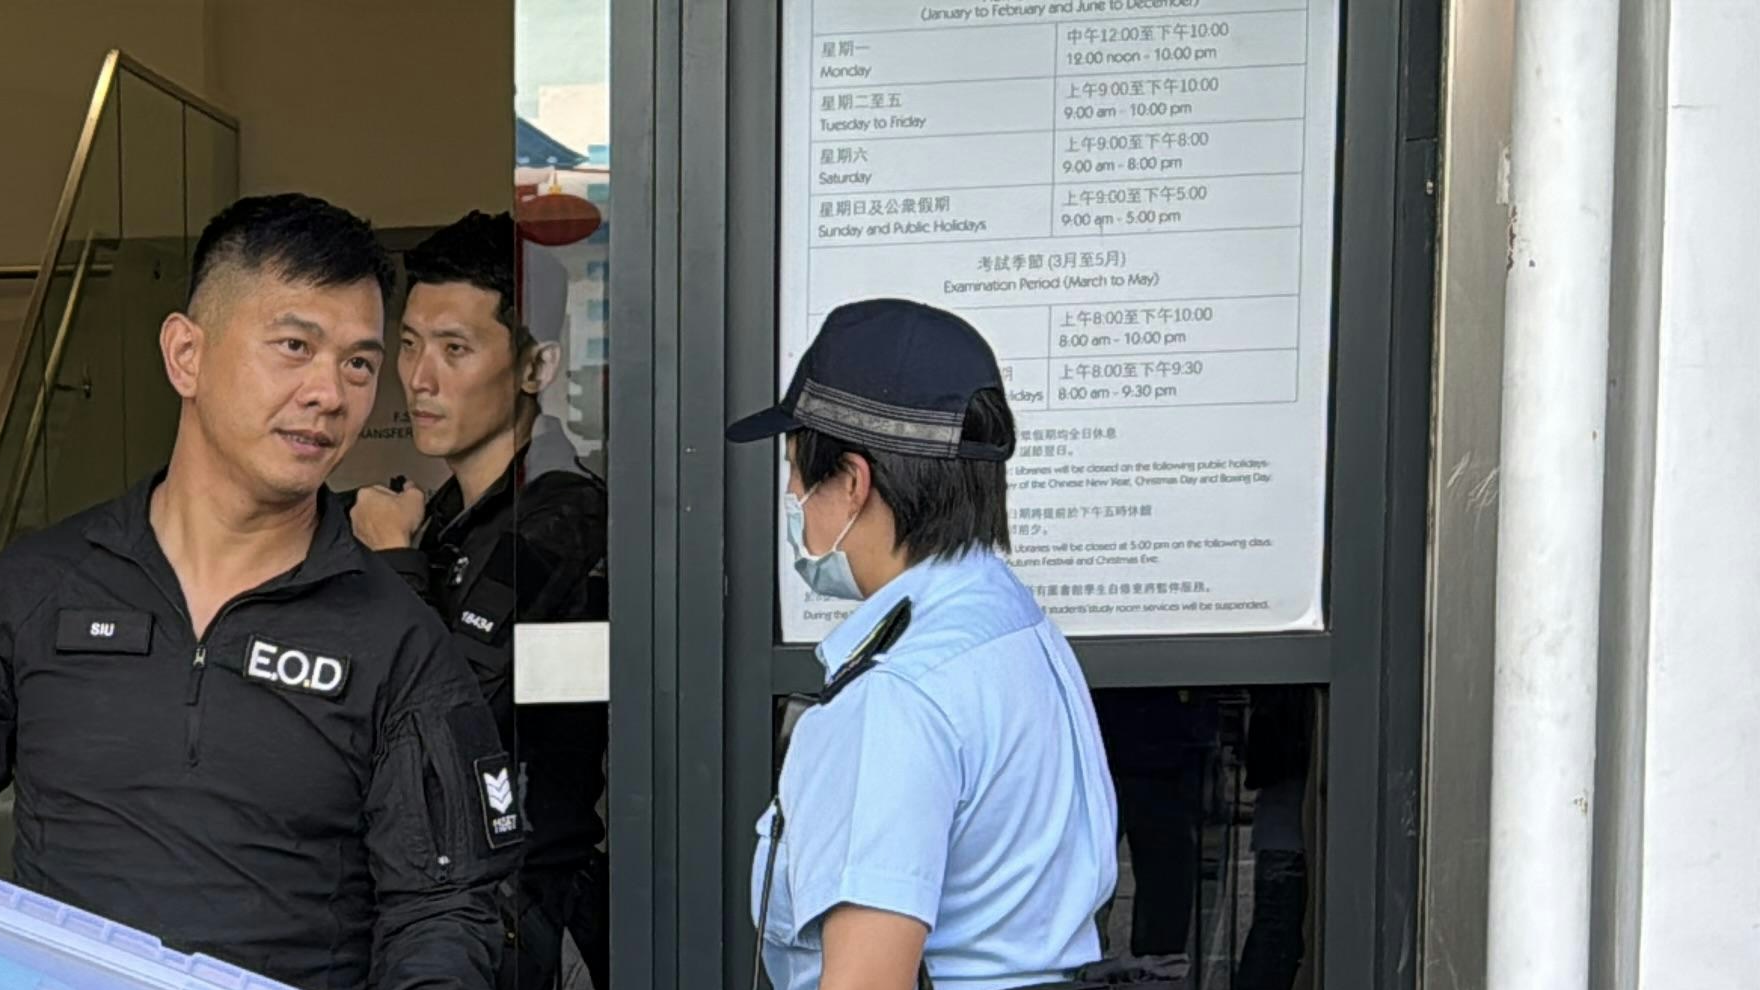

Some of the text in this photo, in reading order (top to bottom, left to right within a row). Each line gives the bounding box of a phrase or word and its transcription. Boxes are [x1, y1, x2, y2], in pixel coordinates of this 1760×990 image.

[920, 8, 972, 22] (January
[975, 7, 989, 18] to
[992, 2, 1047, 17] February
[1048, 0, 1073, 14] and
[1075, 0, 1106, 12] June
[1066, 22, 1229, 43] 中午12:00至下午10:00
[821, 40, 870, 57] 星期一
[1066, 46, 1217, 65] 12:00 noon 10:00 pm
[819, 65, 872, 78] Monday
[1065, 77, 1219, 98] 上午9:00至下午10:00
[820, 92, 902, 111] 星期二至五
[1063, 101, 1192, 119] 9:00 am 10:00 pm
[819, 115, 927, 131] Tuesday to Friday
[1064, 131, 1209, 152] 上午9:00至下午8:00
[819, 147, 868, 164] 星期六
[1061, 156, 1183, 173] 9:00 am 8:00 pm
[818, 171, 872, 184] Saturday
[1061, 185, 1208, 206] 上午9:00至下午5:00
[1060, 209, 1181, 226] 9:00 am 5:00 pm
[817, 219, 987, 237] Sunday and Public Holidays
[976, 250, 1126, 271] 考試季節 (3月至5月)
[943, 272, 1160, 293] Examination Period (March to May)
[1059, 307, 1213, 326] 上午8:00至下午10:00
[1057, 330, 1186, 347] 8:00 am 10:00 pm
[1058, 360, 1203, 379] 上午8:00至下午9:30
[1057, 383, 1177, 400] 8:00 am 9:30 pm
[359, 427, 413, 439] RANSFER
[90, 622, 115, 637] SIU
[248, 641, 342, 692] E.O.D
